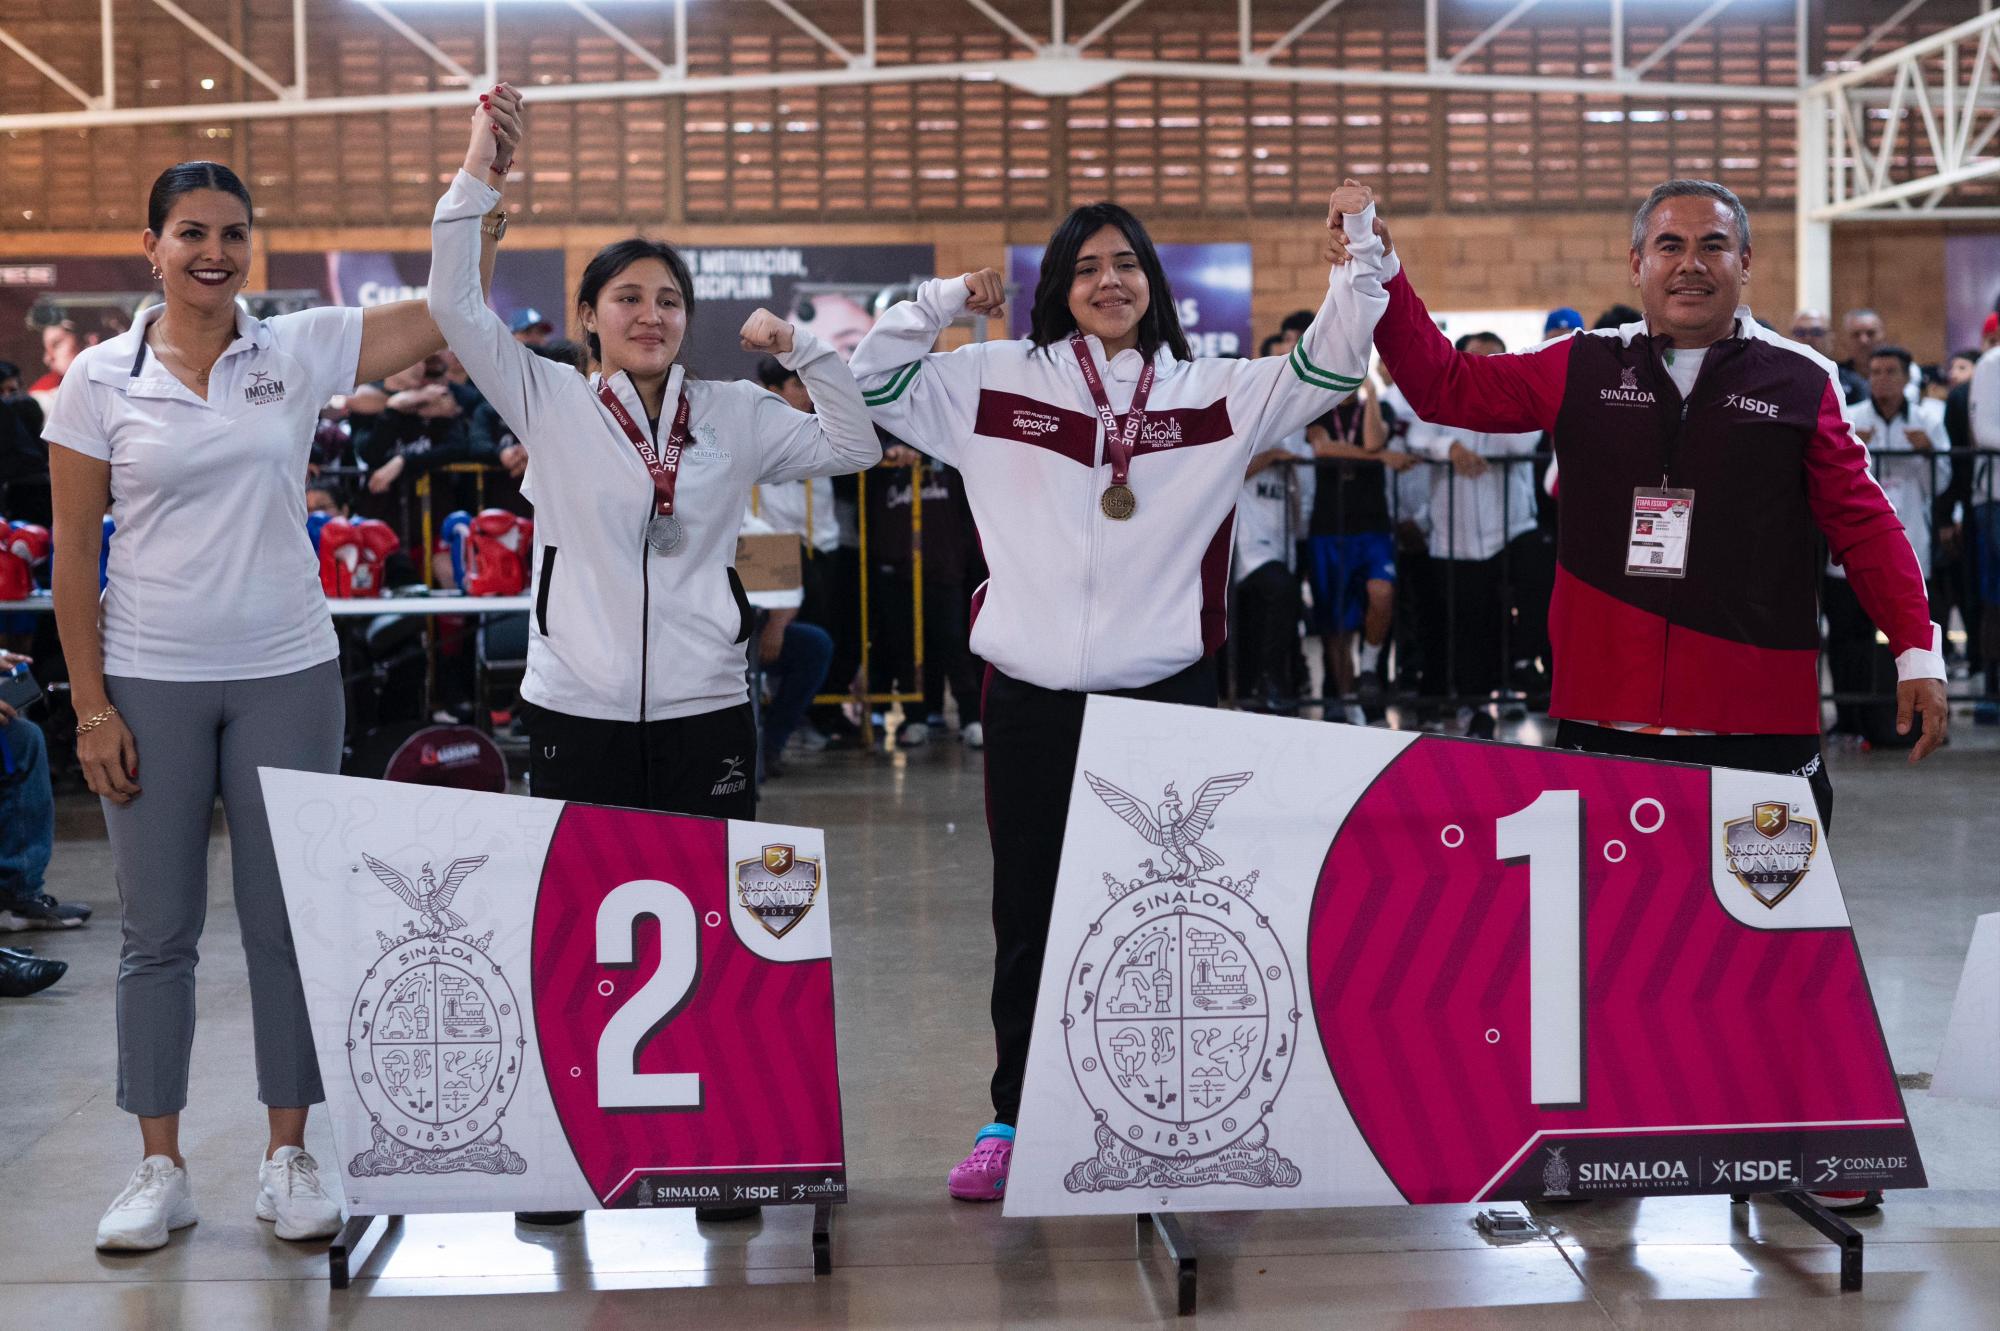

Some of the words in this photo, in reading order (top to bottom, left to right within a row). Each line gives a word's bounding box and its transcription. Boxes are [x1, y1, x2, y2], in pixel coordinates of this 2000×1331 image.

[694, 274, 772, 300] SCIPLINA
[245, 380, 285, 400] IMDEM
[1599, 388, 1657, 403] SINALOA
[1739, 396, 1780, 419] ISDE
[1012, 415, 1059, 433] deporte
[1098, 404, 1118, 431] ISDE
[1122, 418, 1140, 447] ISDE
[1141, 430, 1183, 440] AHOME
[636, 440, 659, 465] ISDE
[663, 444, 681, 472] ISDE
[711, 779, 747, 796] IMDEM
[1726, 841, 1814, 857] NACIONALES
[1727, 855, 1810, 874] CONADE
[738, 879, 817, 892] NACIONALES
[1753, 874, 1788, 883] 2024
[739, 890, 816, 908] CONADE
[1132, 890, 1231, 918] SINALOA
[762, 908, 794, 916] 2024
[399, 945, 473, 966] SINALOA
[1496, 789, 1581, 1105] 1
[595, 879, 700, 1108] 2
[417, 1128, 460, 1143] 1831
[1154, 1128, 1212, 1147] 1831
[1578, 1160, 1689, 1182] SINALOA
[1734, 1159, 1792, 1182] ISDE
[1843, 1156, 1908, 1170] CONADE
[657, 1186, 720, 1199] SINALOA
[746, 1186, 779, 1199] ISDE
[807, 1183, 845, 1193] CONADE
[1579, 1182, 1628, 1190] GOBIERNO
